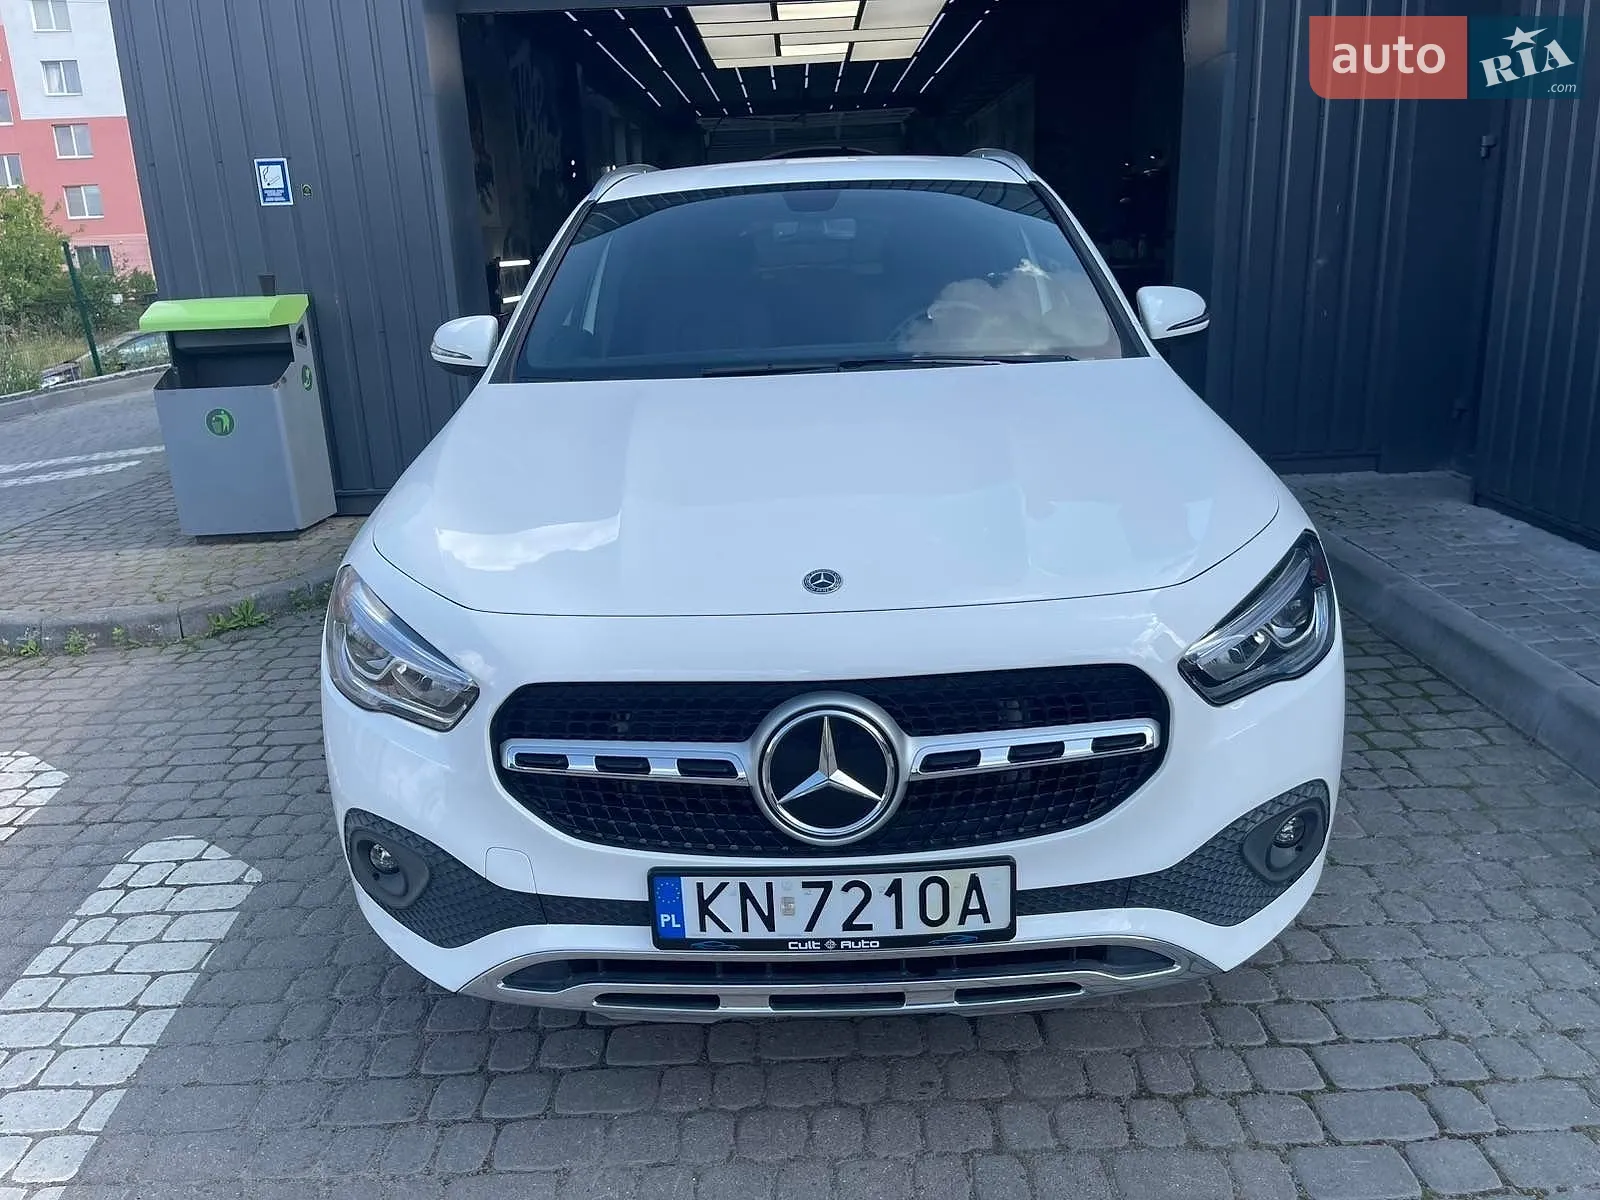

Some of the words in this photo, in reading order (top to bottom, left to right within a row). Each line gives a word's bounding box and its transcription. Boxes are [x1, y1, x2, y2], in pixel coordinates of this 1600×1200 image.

[696, 881, 776, 933] KN
[801, 872, 991, 932] 7210A
[660, 914, 681, 928] PL
[788, 940, 821, 950] Cult
[840, 939, 880, 949] Auto
